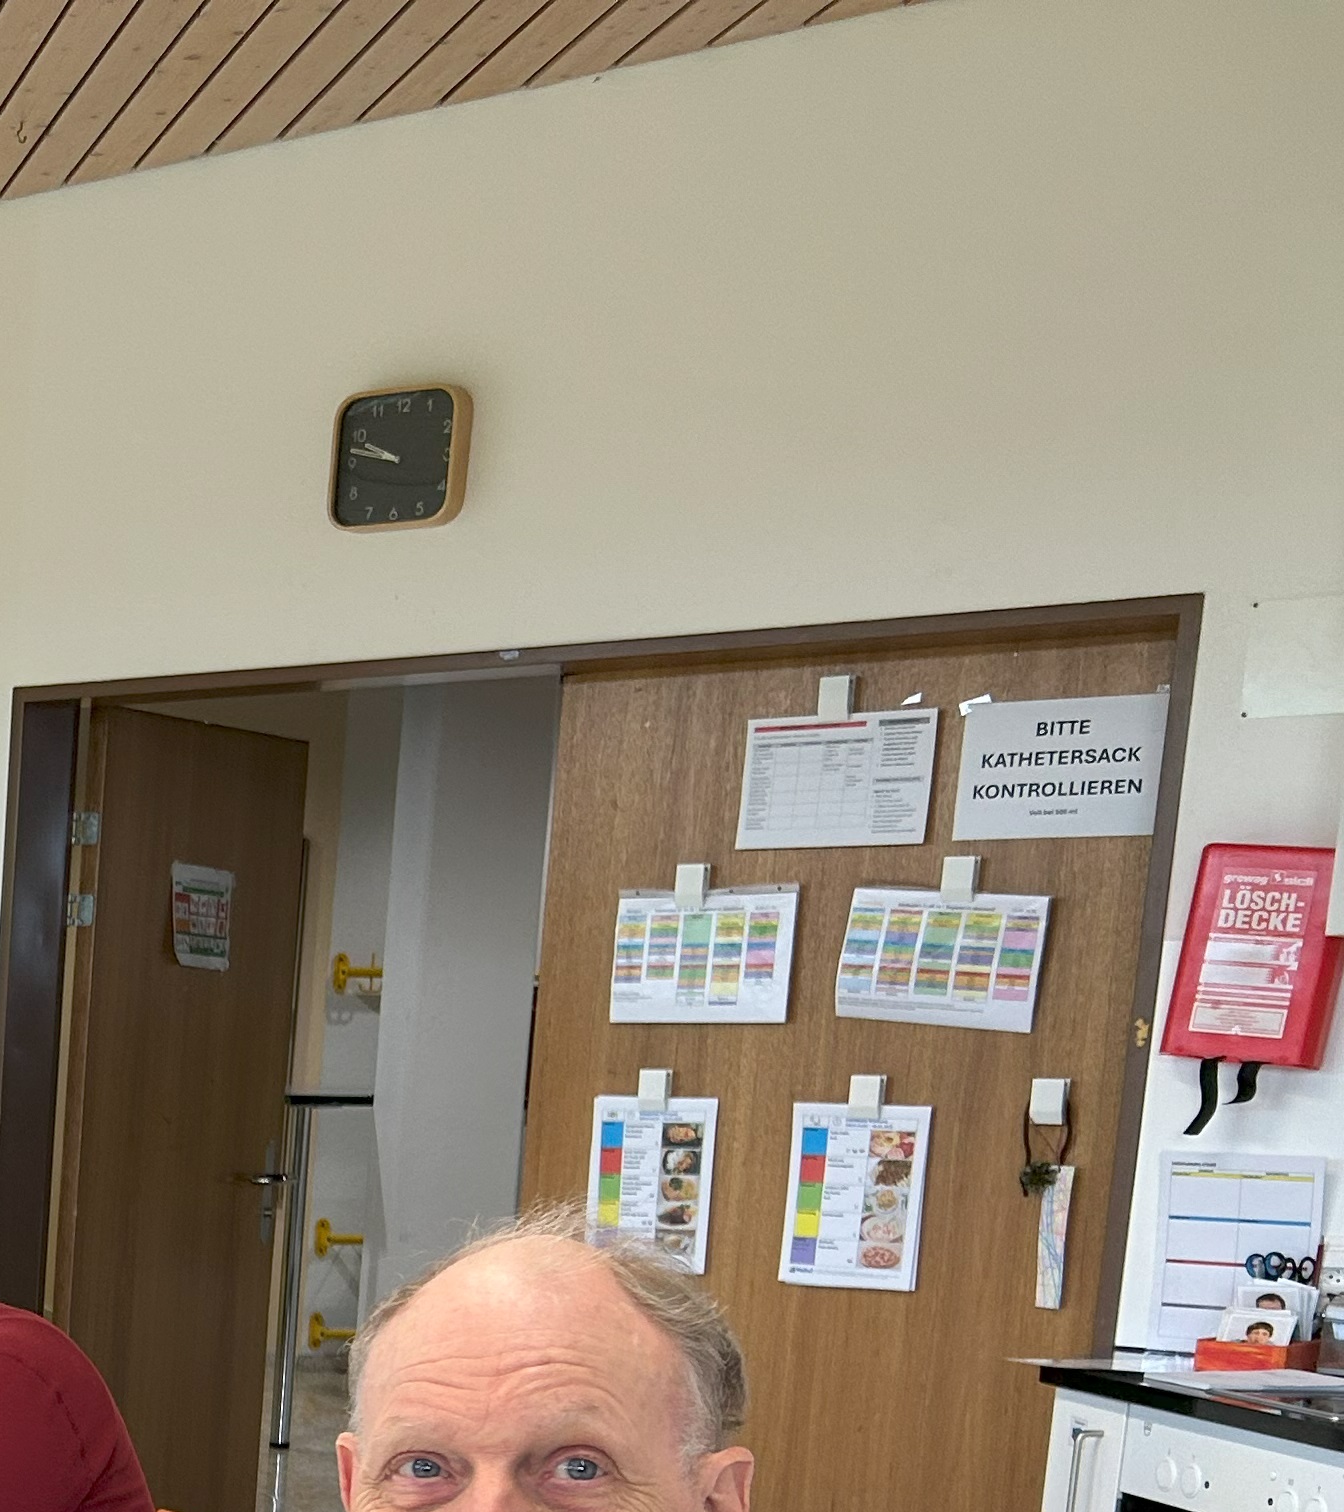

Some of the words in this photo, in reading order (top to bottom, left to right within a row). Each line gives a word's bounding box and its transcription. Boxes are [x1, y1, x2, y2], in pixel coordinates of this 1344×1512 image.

[372, 404, 384, 418] 11
[396, 398, 412, 413] 12
[426, 399, 434, 412] 1
[443, 420, 452, 434] 2
[352, 428, 367, 443] 10
[349, 488, 358, 500] 8
[364, 506, 373, 521] 7
[388, 508, 399, 521] 6
[415, 502, 425, 516] 5
[1036, 719, 1092, 737] BITTE
[981, 746, 1143, 769] KATHETERSACK
[972, 778, 1144, 800] KONTROLLIEREN
[1221, 885, 1306, 912] LÖSCH-
[1217, 909, 1303, 933] DECKE
